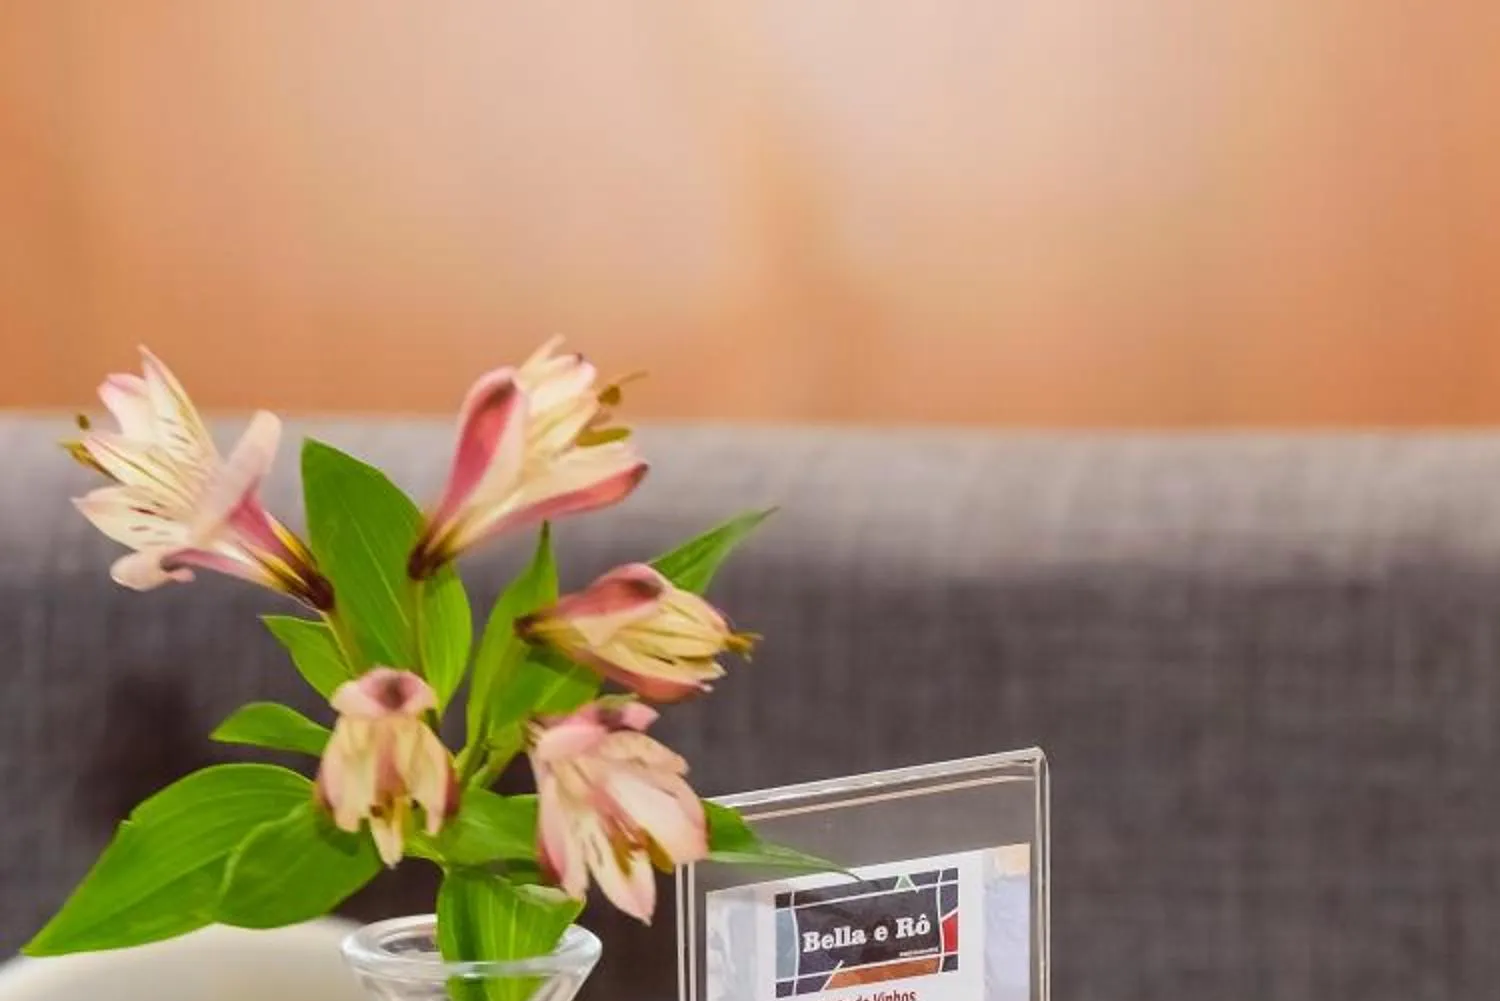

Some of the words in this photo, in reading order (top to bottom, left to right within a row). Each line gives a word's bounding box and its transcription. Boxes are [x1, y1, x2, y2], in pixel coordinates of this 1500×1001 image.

[802, 925, 867, 953] Bella
[873, 925, 889, 941] e
[895, 913, 932, 939] Rô
